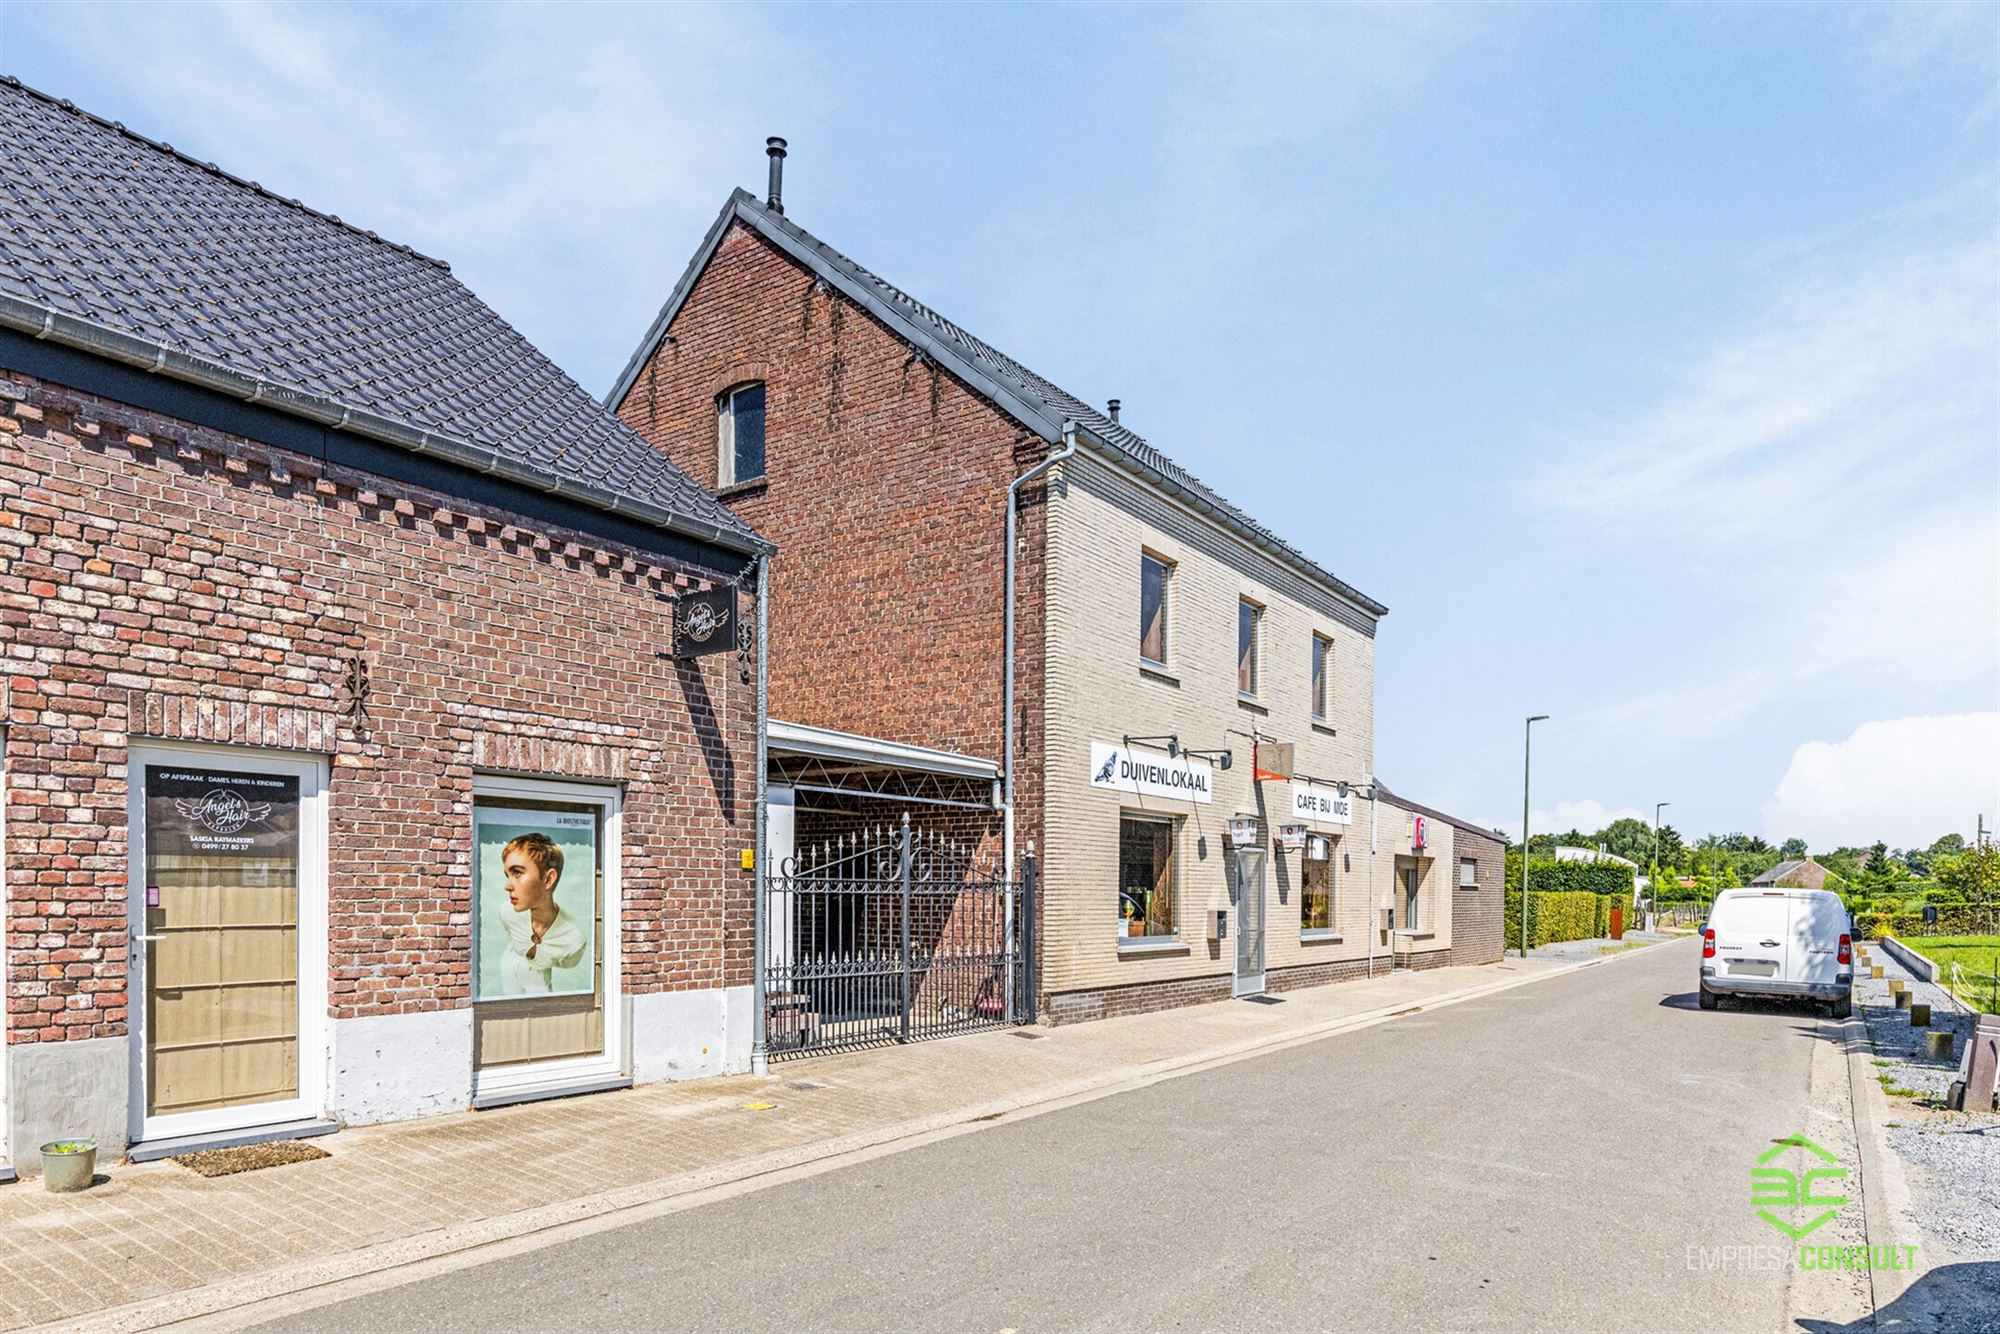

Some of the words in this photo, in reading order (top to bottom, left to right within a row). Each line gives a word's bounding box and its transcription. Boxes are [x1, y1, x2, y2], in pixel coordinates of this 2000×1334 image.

[170, 774, 204, 782] AFSPRAAK
[1121, 760, 1208, 792] DUIVENLOKAAL
[192, 797, 241, 816] Angel's
[1297, 794, 1317, 811] CAFE
[1320, 798, 1331, 813] BIJ
[1333, 800, 1348, 816] MOE
[216, 809, 250, 825] Hair
